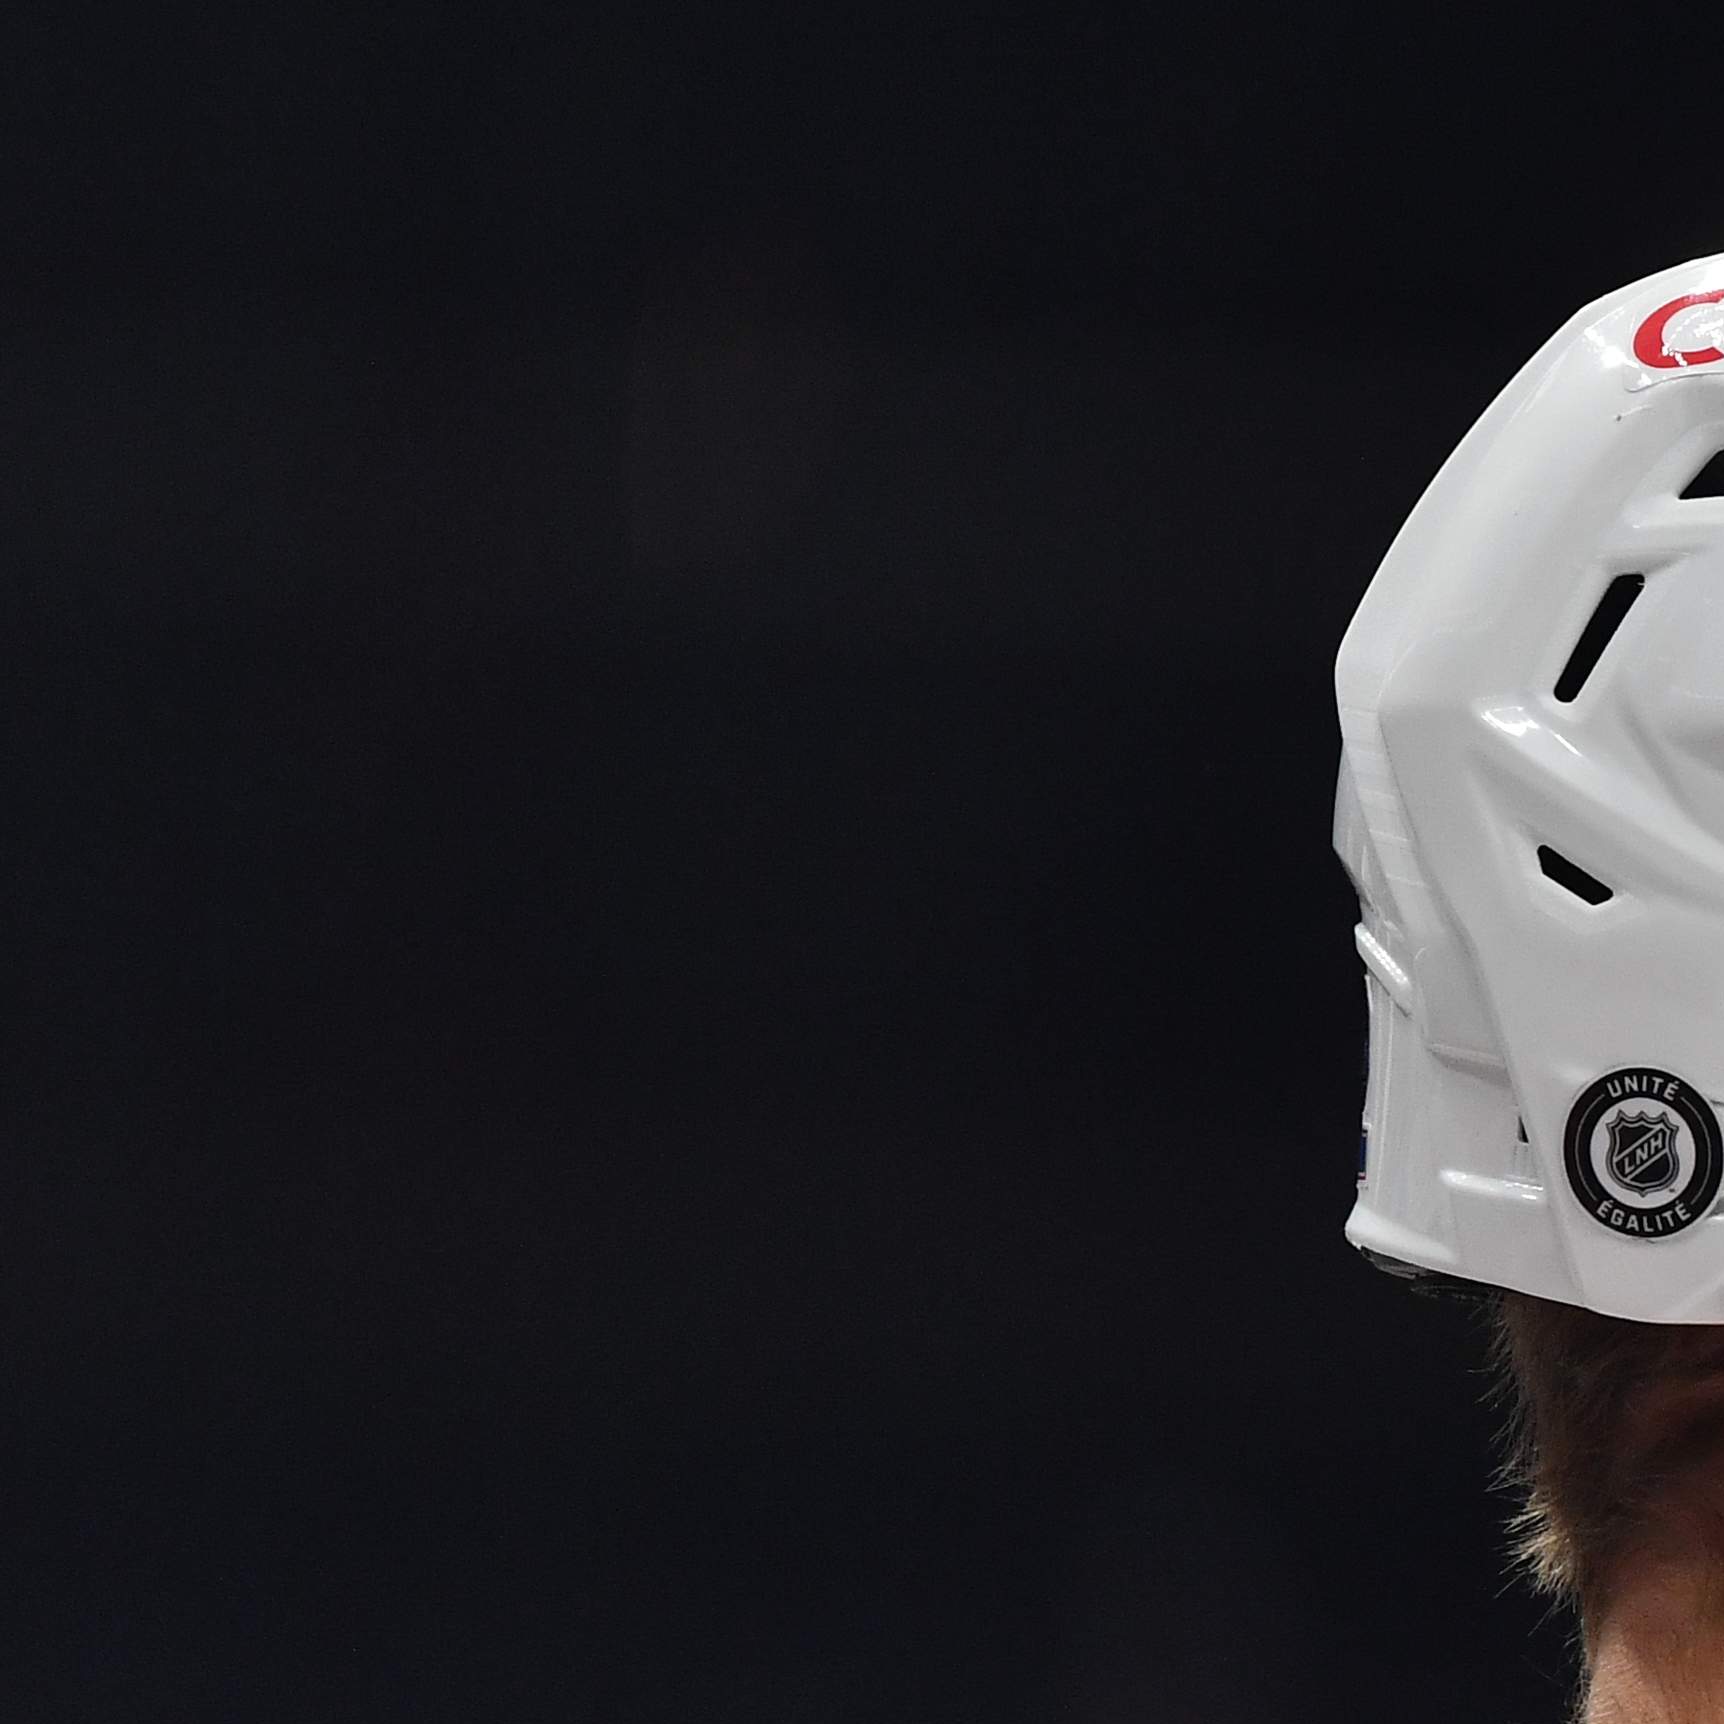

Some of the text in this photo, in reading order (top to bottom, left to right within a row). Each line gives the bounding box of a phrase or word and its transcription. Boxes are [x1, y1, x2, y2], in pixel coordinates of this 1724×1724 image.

[1606, 1074, 1680, 1101] UNITÉ
[1622, 1132, 1664, 1175] LNH
[1596, 1199, 1692, 1233] ÉGALITÉ
